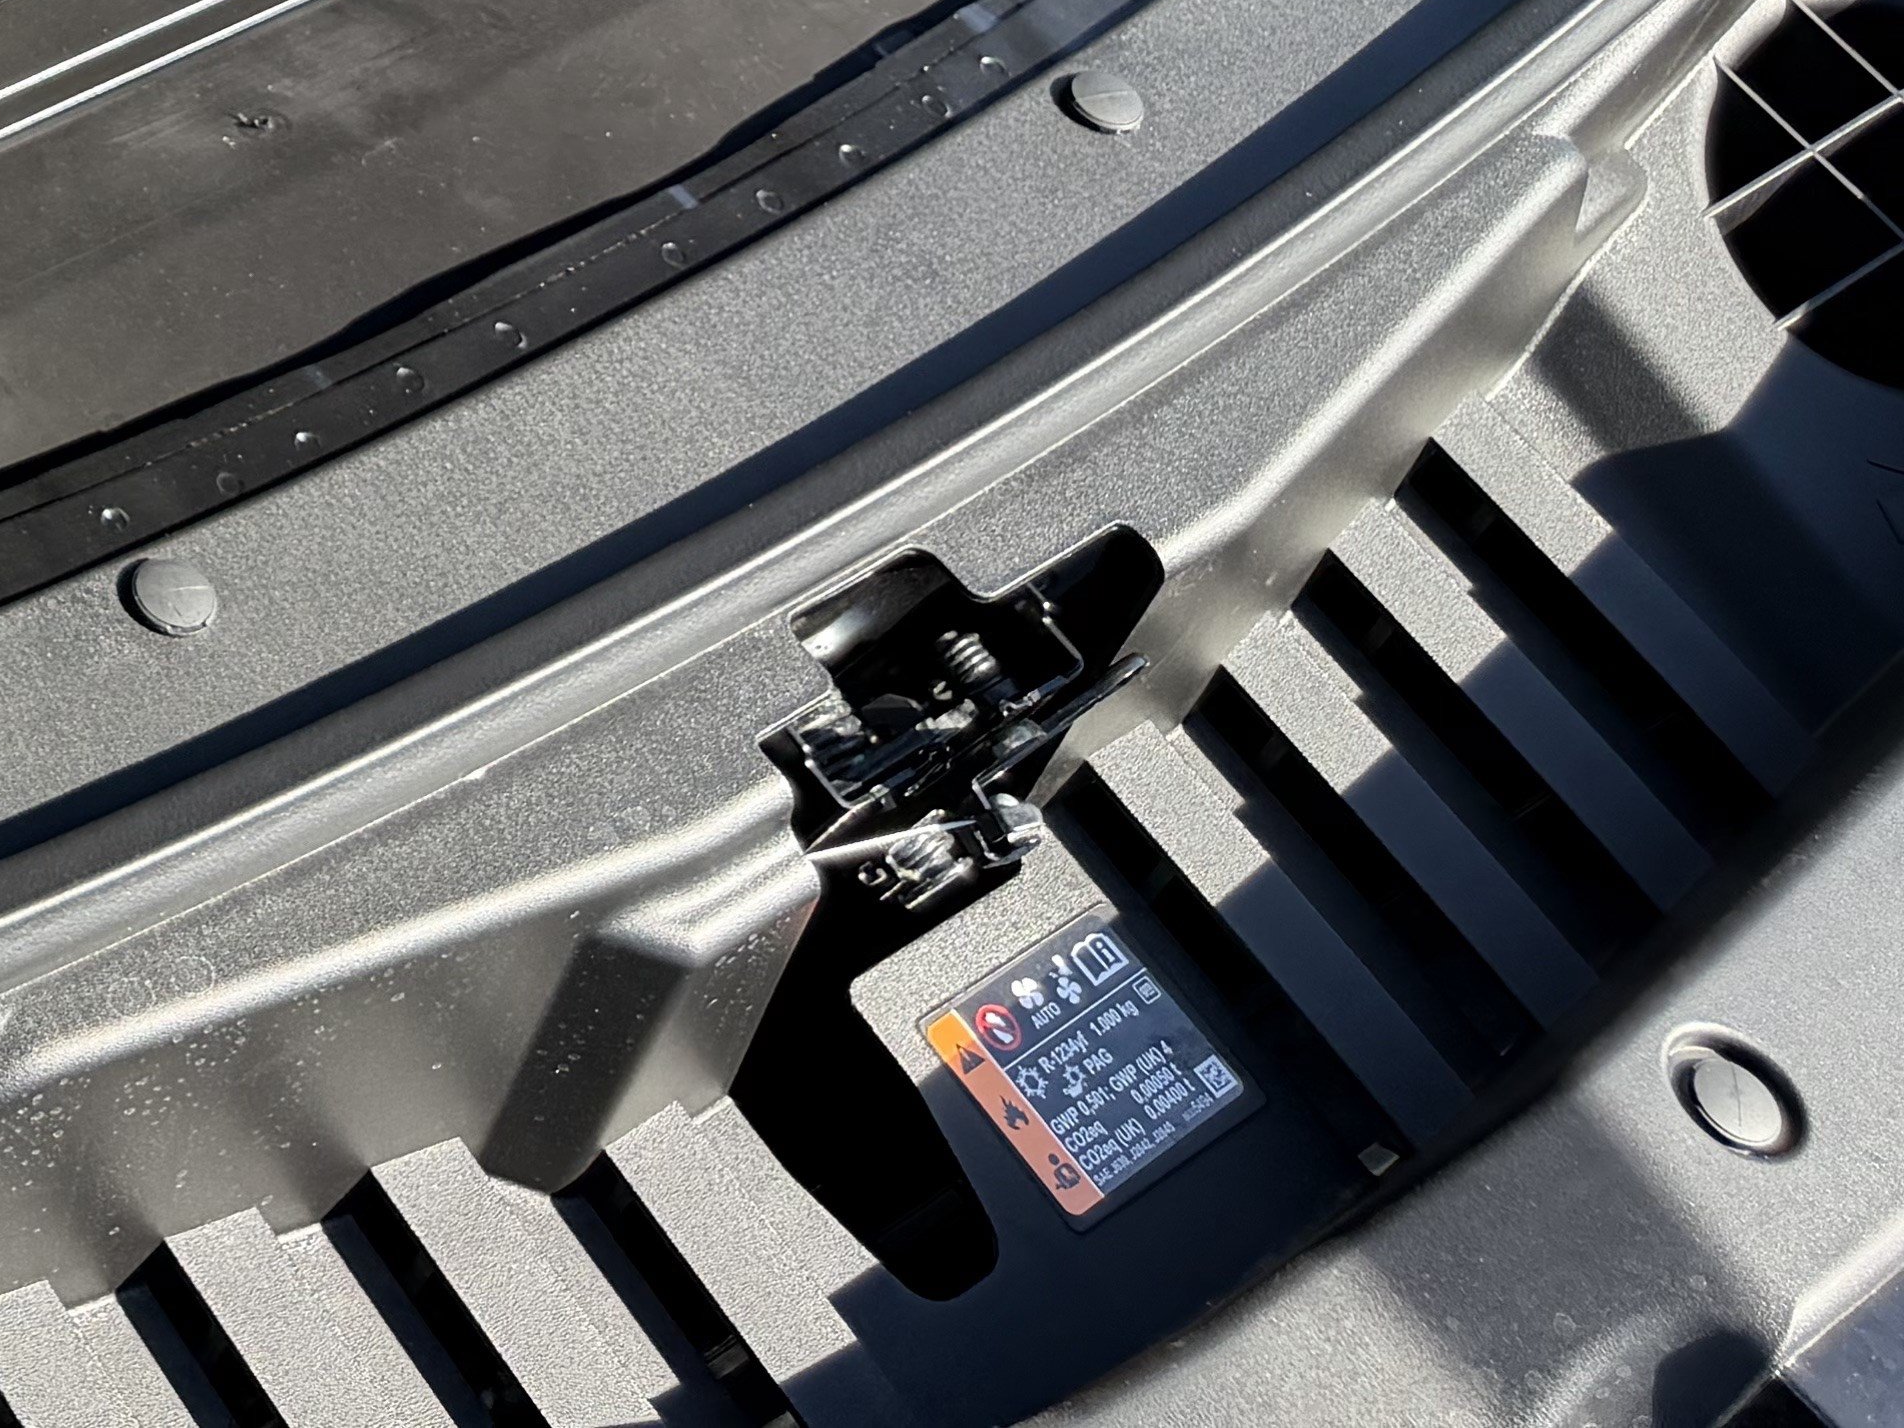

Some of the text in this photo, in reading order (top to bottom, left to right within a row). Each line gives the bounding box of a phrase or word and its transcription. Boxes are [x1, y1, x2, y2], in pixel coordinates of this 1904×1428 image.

[1031, 1002, 1061, 1029] AUTO
[1038, 1000, 1139, 1073] R-1234yf 1.000 kg
[1050, 1106, 1080, 1135] GWP
[1109, 1063, 1137, 1092] GWP
[1136, 1046, 1167, 1076] (UK)
[1160, 1040, 1173, 1055] 4
[1083, 1048, 1113, 1074] PAG
[1064, 1120, 1109, 1153] CO2eq
[1169, 1061, 1182, 1075] t
[1078, 1138, 1123, 1171] CO2eq
[1114, 1117, 1146, 1147] (UK)
[1183, 1077, 1195, 1092] t
